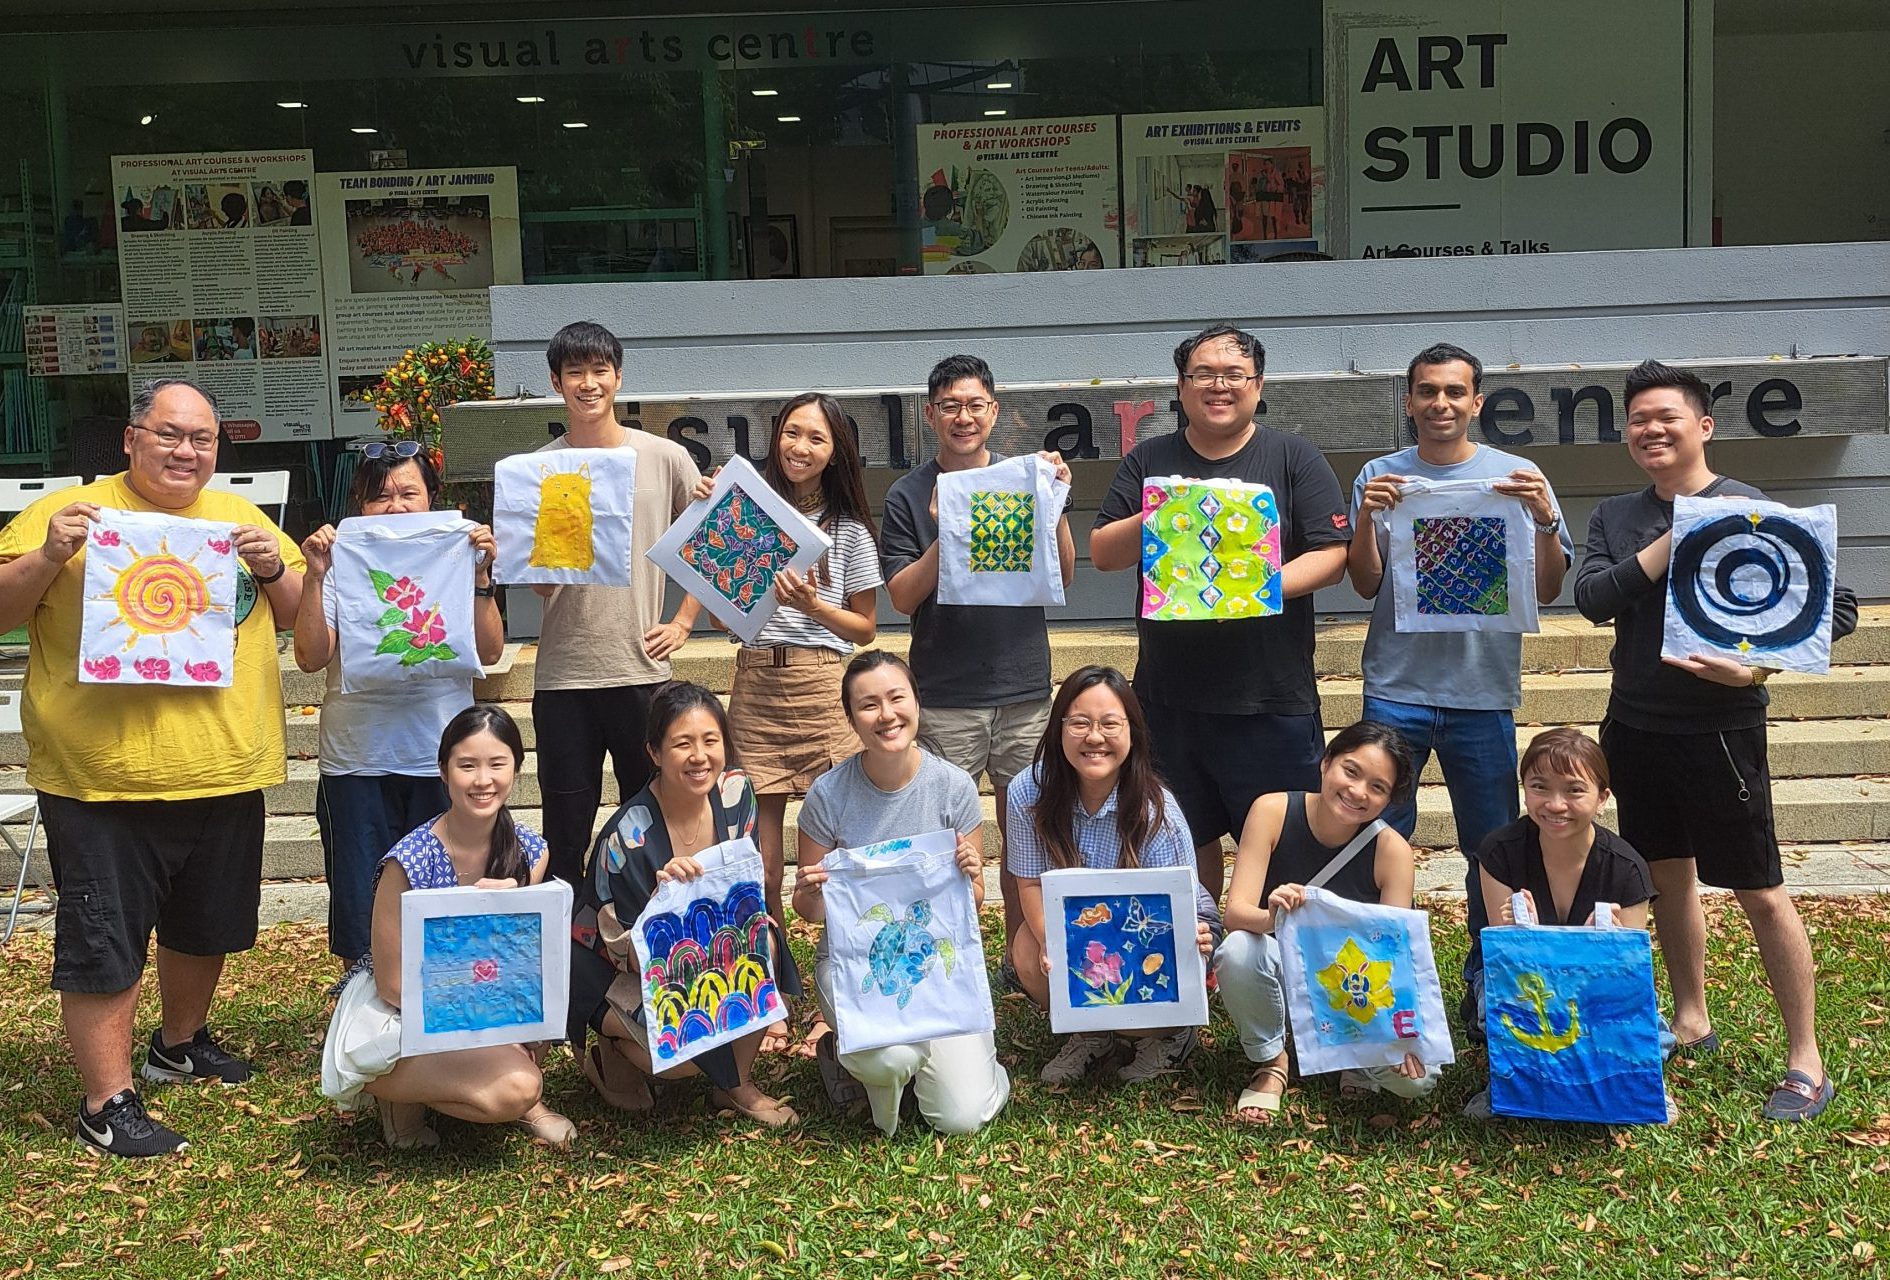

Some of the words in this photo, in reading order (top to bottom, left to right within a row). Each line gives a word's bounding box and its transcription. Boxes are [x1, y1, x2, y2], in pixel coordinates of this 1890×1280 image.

[402, 29, 560, 68] visual
[585, 28, 684, 65] arts
[707, 25, 875, 63] centre
[1360, 33, 1508, 93] ART
[933, 126, 1018, 140] PROFESSIONAL
[1020, 124, 1044, 136] ART
[1046, 122, 1097, 134] COURSES
[1145, 125, 1170, 138] ART
[1171, 121, 1241, 136] EXHIBITIONS
[1243, 122, 1254, 134] &
[1256, 119, 1301, 132] EVENTS
[962, 141, 972, 150] &
[974, 140, 996, 150] ART
[999, 136, 1071, 148] WORKSHOPS
[1183, 138, 1214, 146] @VISUAL
[1234, 135, 1260, 144] CENTRE
[1362, 117, 1653, 182] STUDIO
[121, 159, 184, 168] PROFESSIONAL
[204, 157, 243, 165] COURSES
[252, 155, 306, 164] WORKSHOPS
[976, 152, 1009, 162] @VISUAL
[1010, 152, 1030, 160] ARTS
[1031, 150, 1059, 158] CENTRE
[340, 178, 367, 189] TEAM
[370, 176, 414, 188] BONDING
[416, 176, 422, 187] /
[425, 174, 446, 186] ART
[449, 173, 494, 185] JAMMING
[1362, 243, 1390, 260] Art
[1480, 242, 1494, 257] &
[1500, 239, 1550, 256] Talks
[396, 308, 425, 316] workshops
[548, 394, 912, 478] sul
[1047, 399, 1267, 461] ar
[1407, 379, 1802, 445] ene
[1392, 1010, 1420, 1039] E
